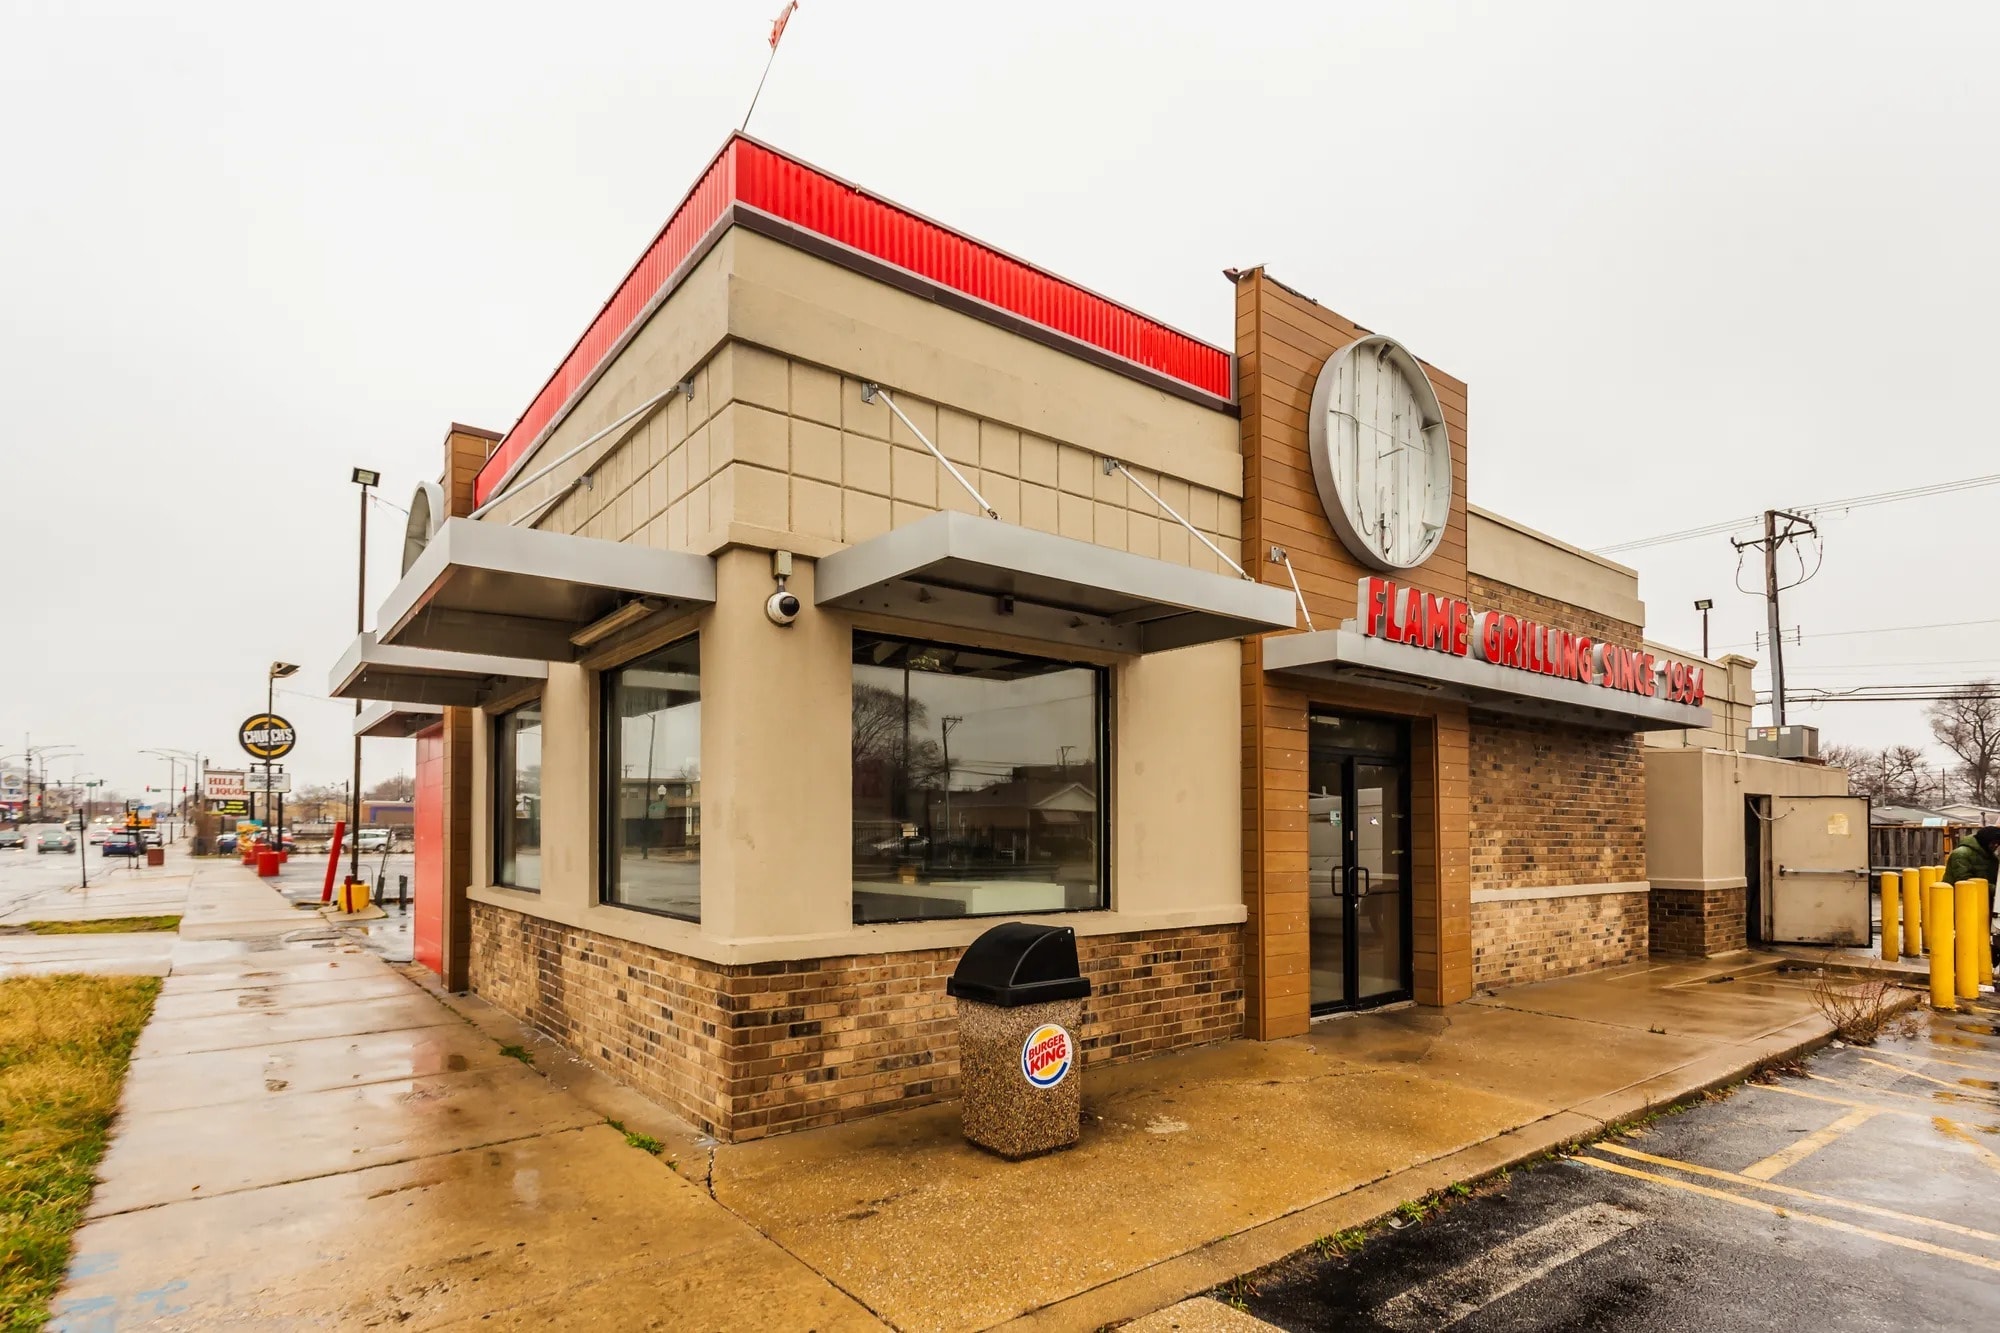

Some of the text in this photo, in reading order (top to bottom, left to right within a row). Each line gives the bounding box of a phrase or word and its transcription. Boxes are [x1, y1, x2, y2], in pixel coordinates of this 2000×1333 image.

[1366, 576, 1705, 706] FLAME GRILLING SINCE 1954
[1028, 1033, 1065, 1061] BURGER
[1030, 1043, 1066, 1076] KING
